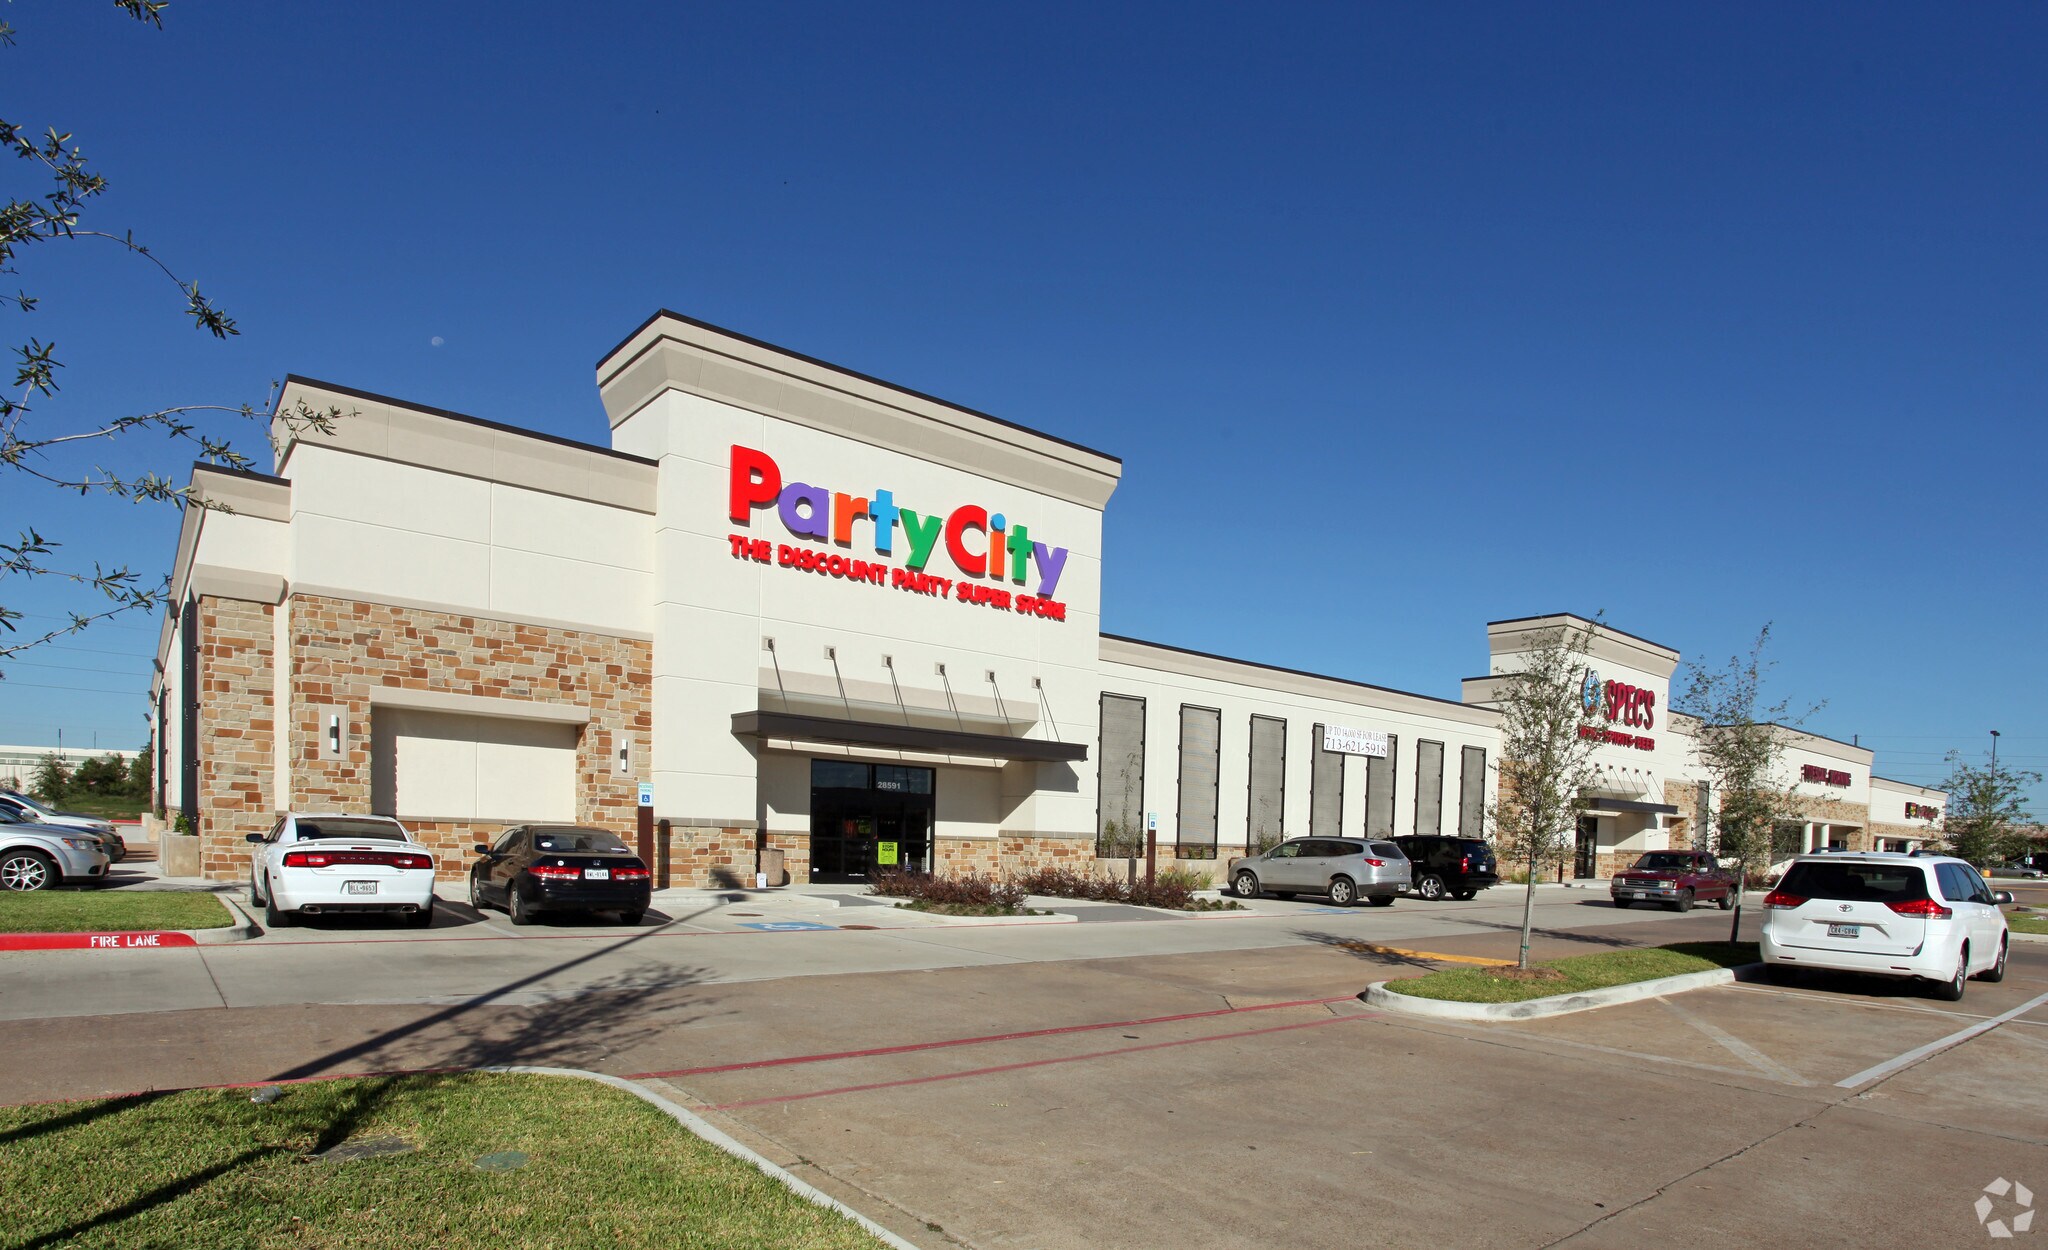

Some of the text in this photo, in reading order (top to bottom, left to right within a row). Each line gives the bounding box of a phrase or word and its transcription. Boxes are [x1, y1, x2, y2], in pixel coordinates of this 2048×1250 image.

[728, 534, 1066, 622] THE DISCOUNT PARTY SUPER STORE
[1334, 726, 1342, 736] TO
[1363, 730, 1372, 740] FOR
[1373, 732, 1387, 742] LEASE
[1325, 737, 1386, 755] 713-621-5918
[877, 781, 900, 790] 28591
[91, 935, 160, 947] FIRE LANE
